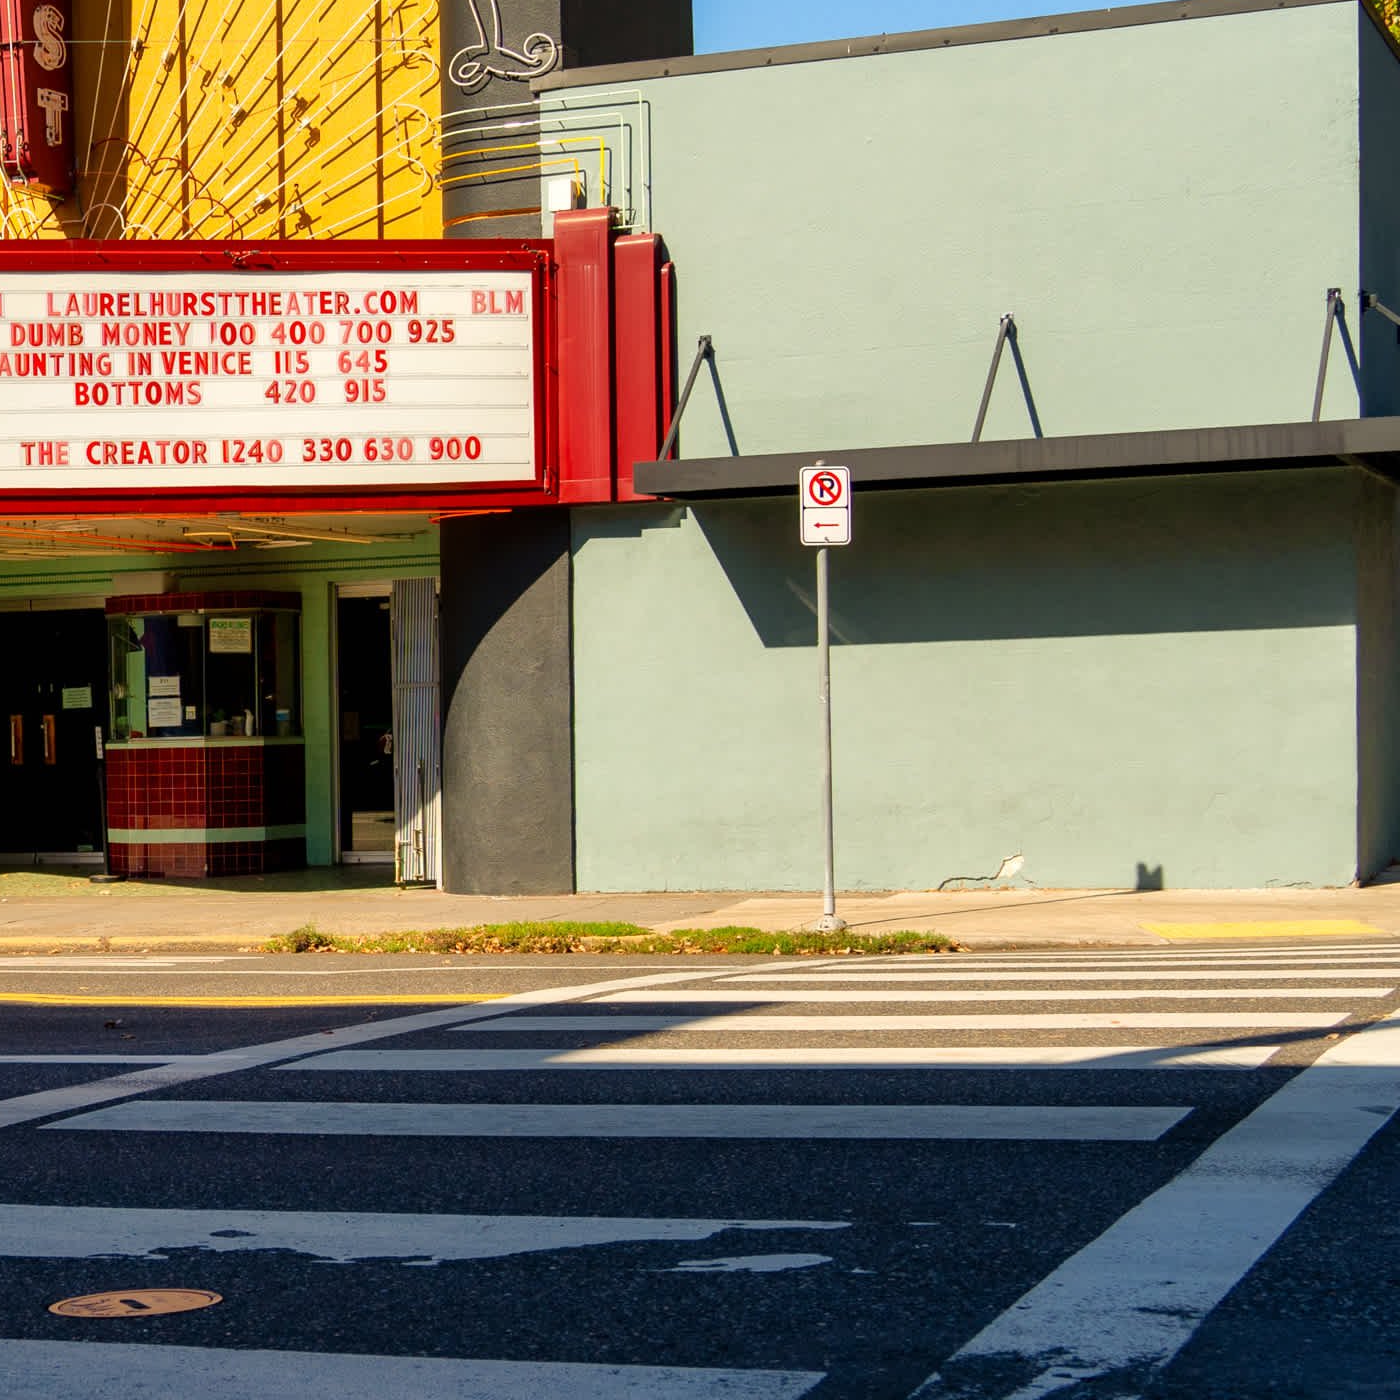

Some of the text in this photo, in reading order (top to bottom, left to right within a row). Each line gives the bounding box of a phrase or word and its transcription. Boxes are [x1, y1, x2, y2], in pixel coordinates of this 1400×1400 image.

[47, 290, 418, 317] LAURELHURSTTHEATER.COM
[471, 290, 523, 315] BLM
[10, 319, 456, 347] DUMB MONEY 100 400 700 925
[128, 352, 151, 377] IN
[161, 351, 252, 376] VENICE
[274, 350, 310, 374] 115
[337, 349, 388, 374] 645
[74, 378, 386, 406] BOTTOMS 420 915
[20, 437, 482, 466] THE CREATOR 1240 330 630 900
